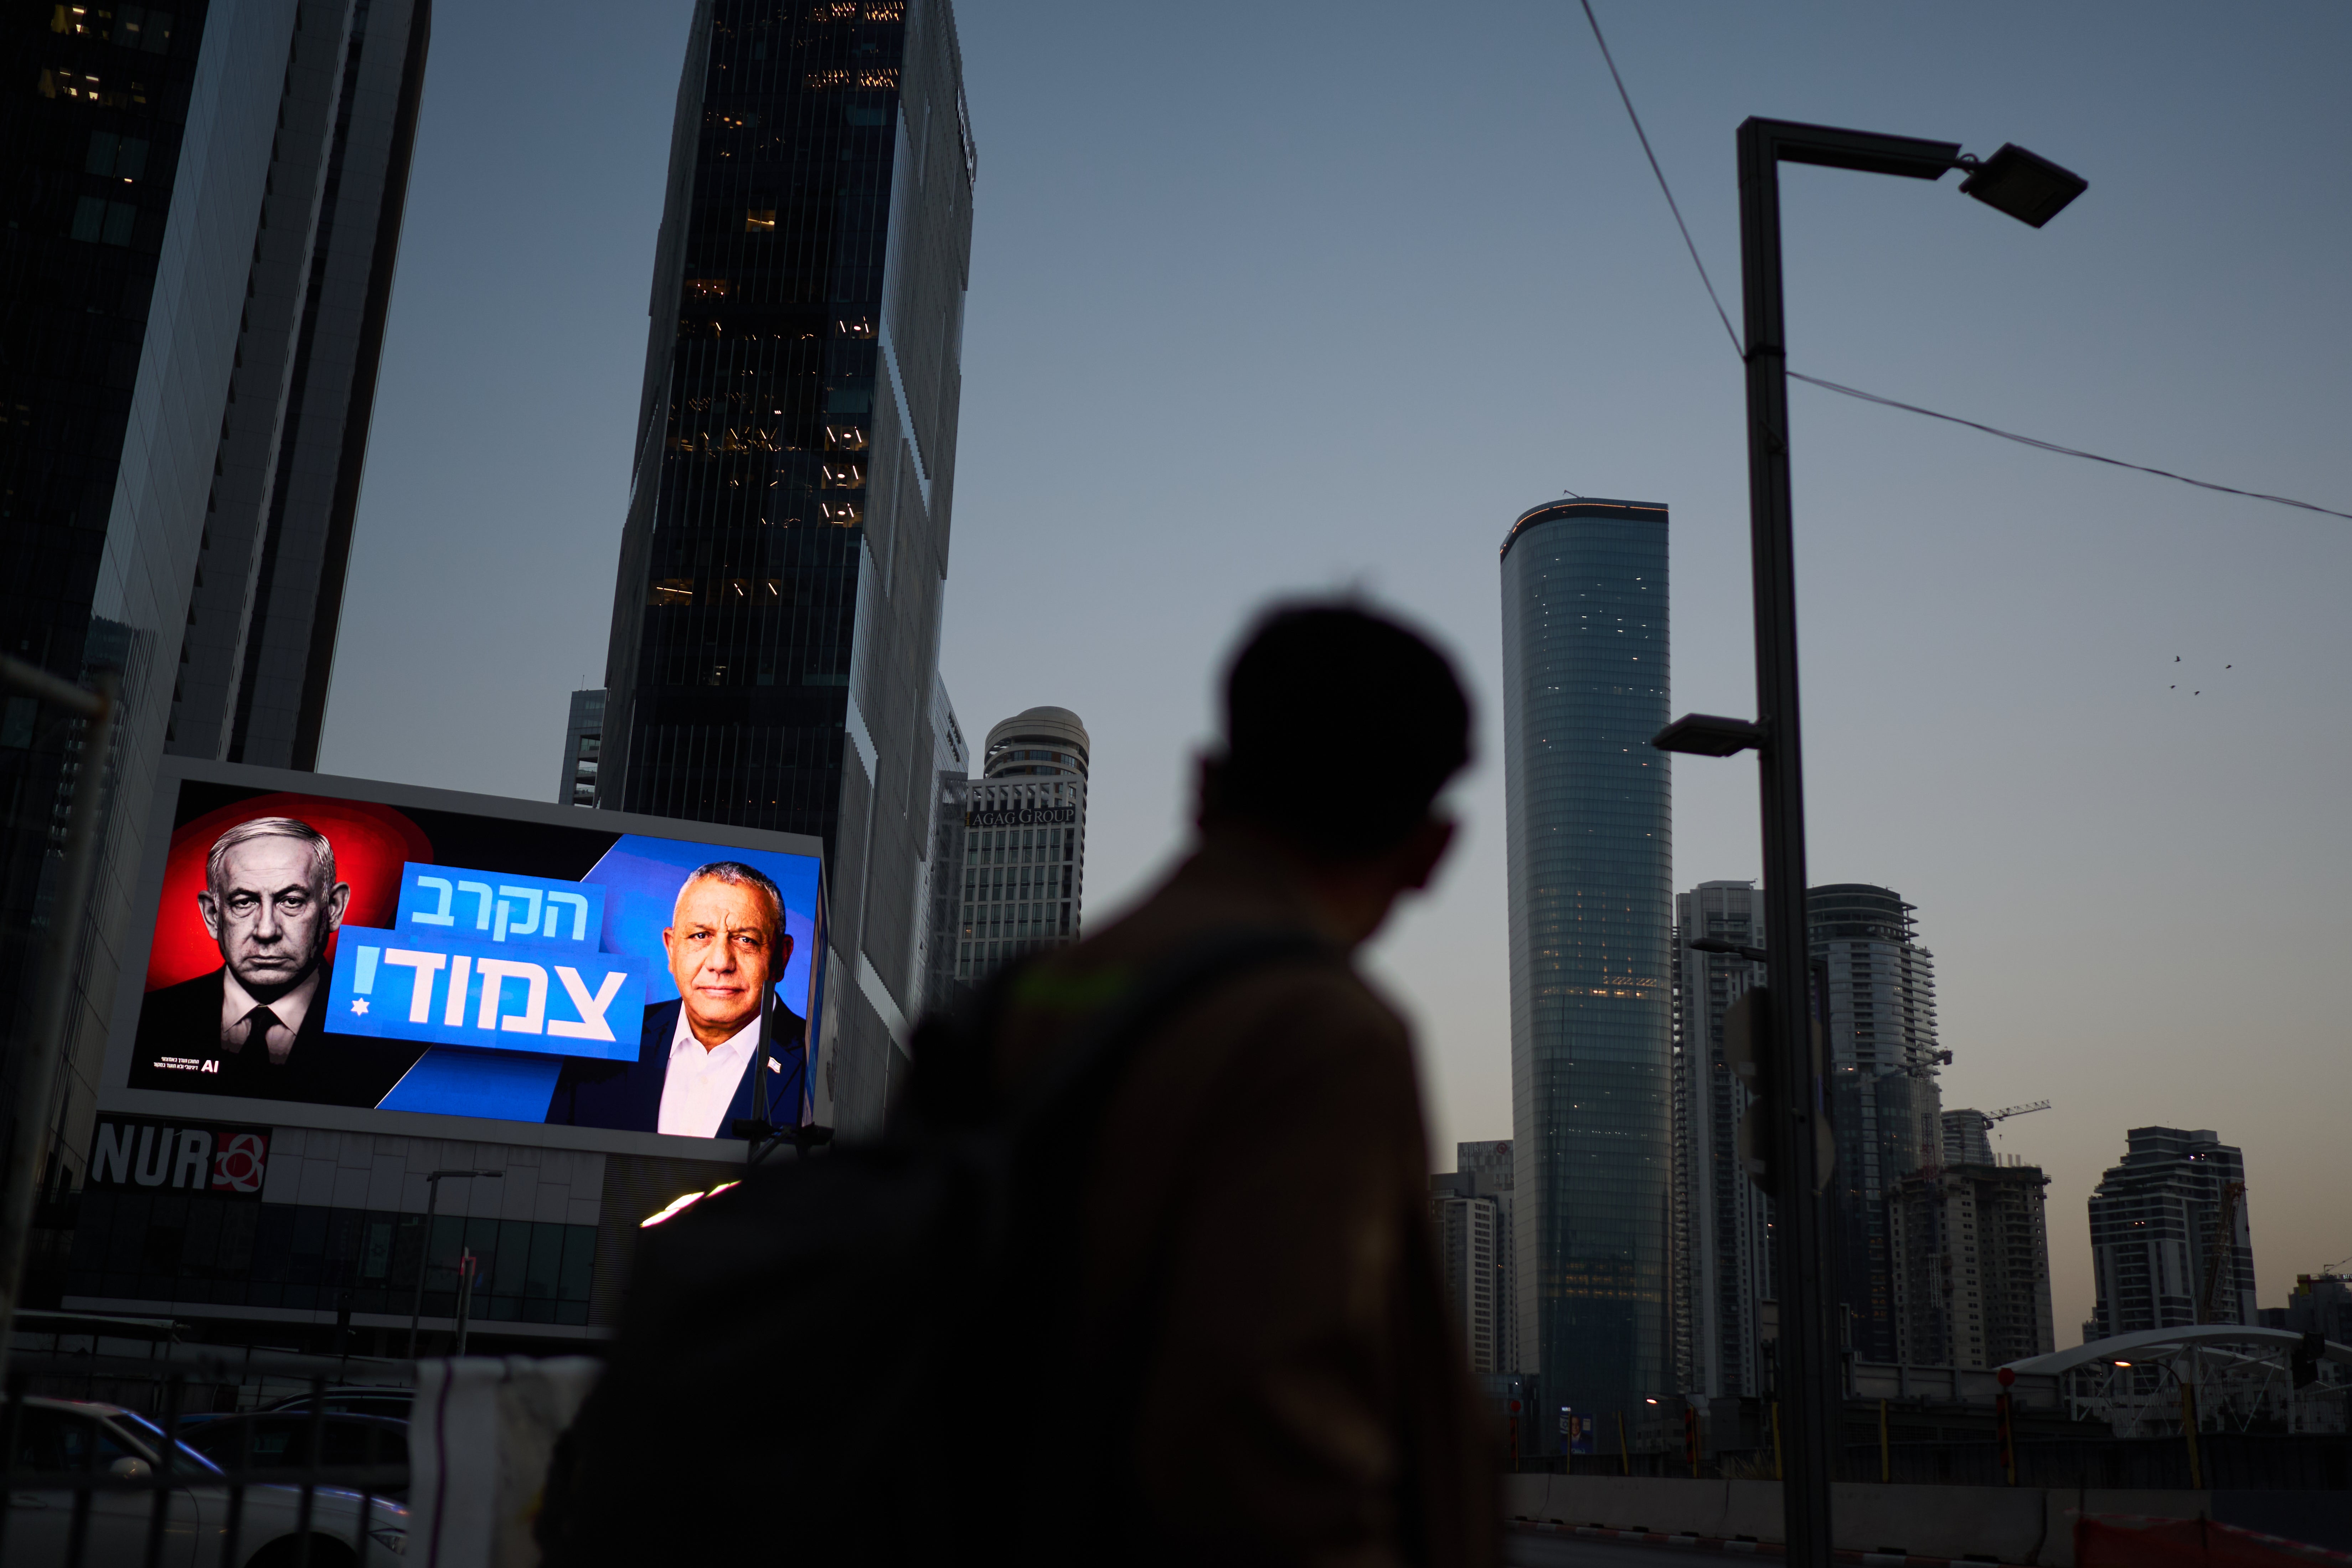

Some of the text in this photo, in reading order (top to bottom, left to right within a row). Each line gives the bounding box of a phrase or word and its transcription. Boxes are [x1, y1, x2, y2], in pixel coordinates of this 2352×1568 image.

[1019, 808, 1074, 823] GROUP
[412, 875, 588, 942] הקרב
[350, 945, 628, 1041] צמוד!
[201, 1060, 219, 1073] AI
[92, 1123, 212, 1190] NUR
